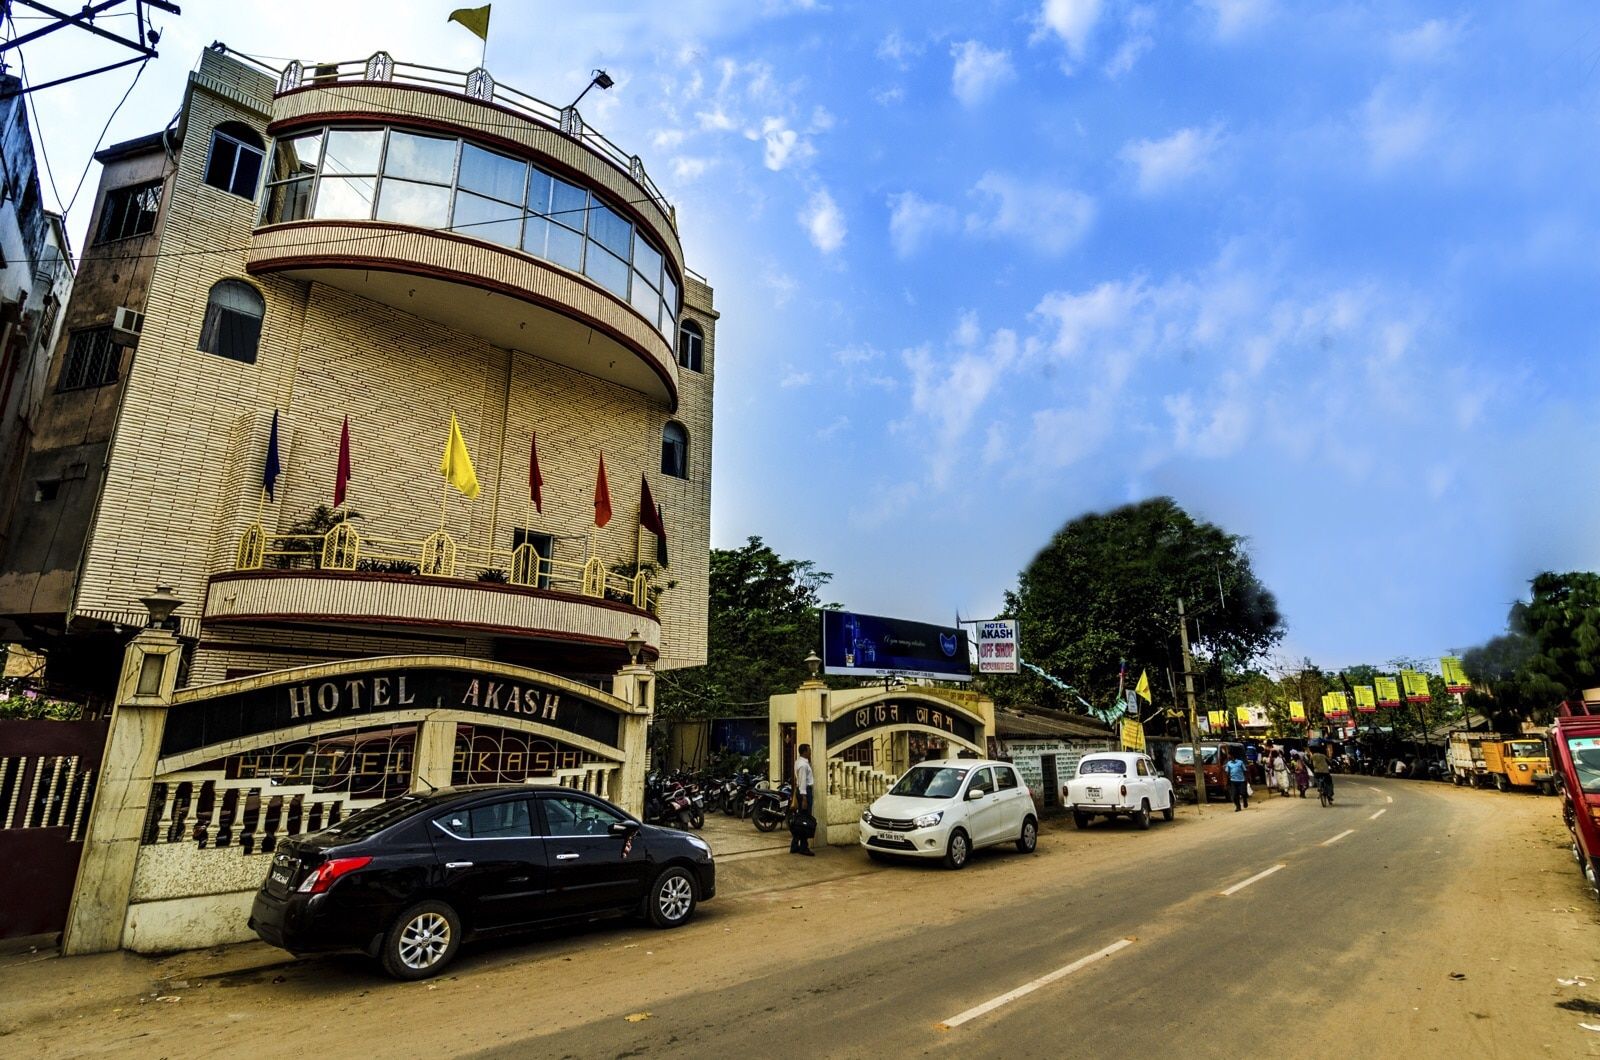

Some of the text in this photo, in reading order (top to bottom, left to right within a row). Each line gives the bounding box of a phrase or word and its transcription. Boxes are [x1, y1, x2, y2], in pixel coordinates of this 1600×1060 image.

[981, 629, 1013, 639] AKASH
[980, 642, 1014, 658] OFF SHOP
[289, 676, 561, 721] HOTEL AKASH
[855, 703, 953, 733] হোটেল আকাশ
[237, 751, 576, 779] HOTEL AKASH
